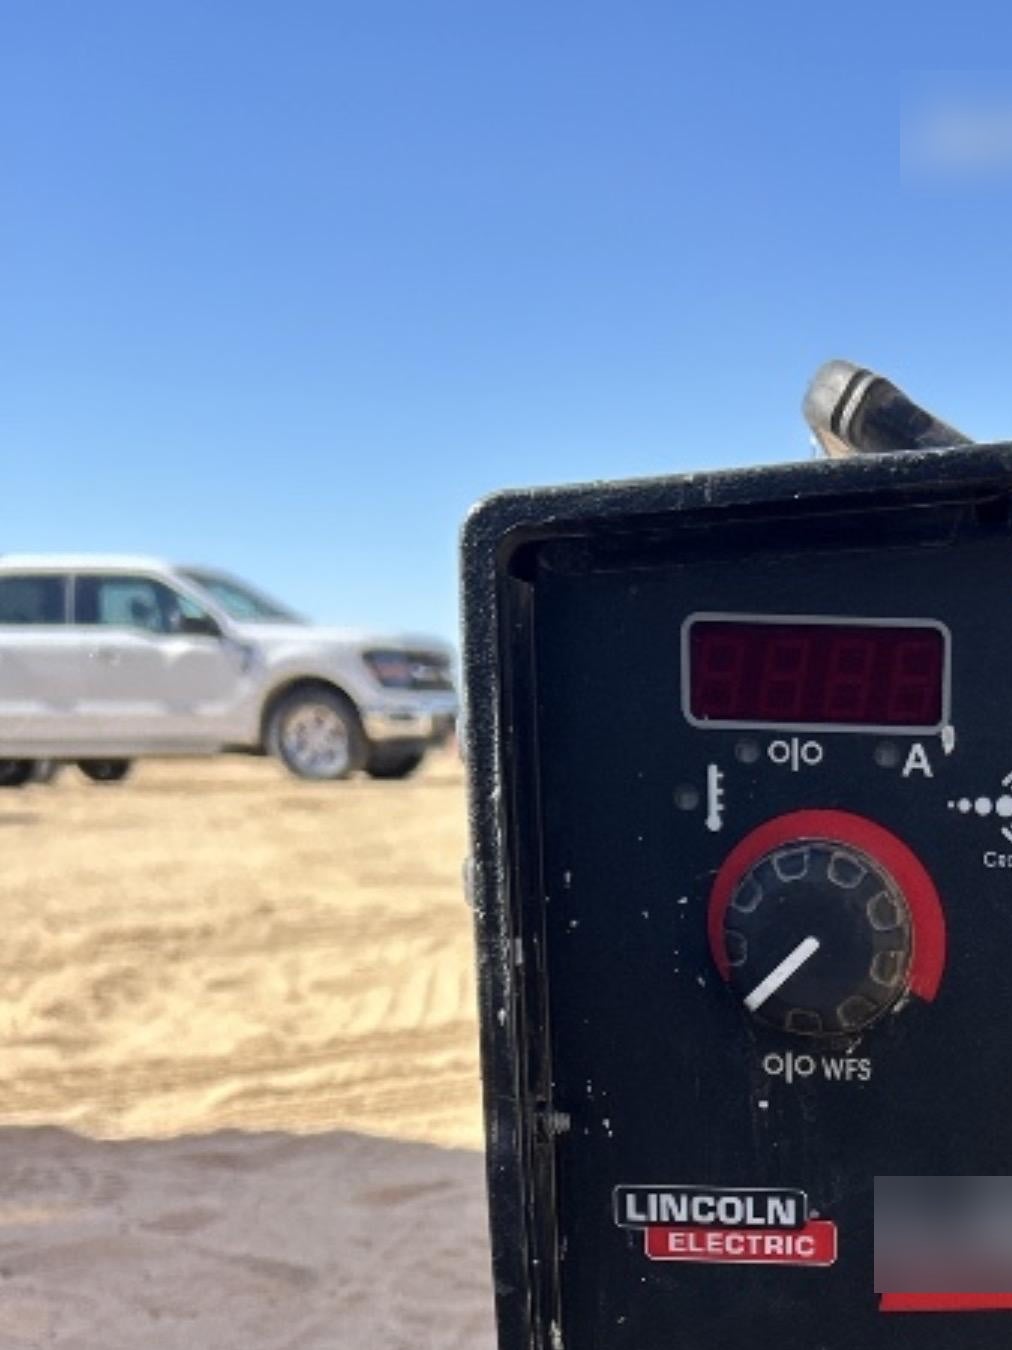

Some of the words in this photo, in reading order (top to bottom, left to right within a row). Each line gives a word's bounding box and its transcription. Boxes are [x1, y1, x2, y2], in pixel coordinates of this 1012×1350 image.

[902, 744, 934, 778] A
[820, 1056, 872, 1081] WFS
[626, 1194, 796, 1225] LINCOLN
[667, 1232, 816, 1256] ELECTRIC
